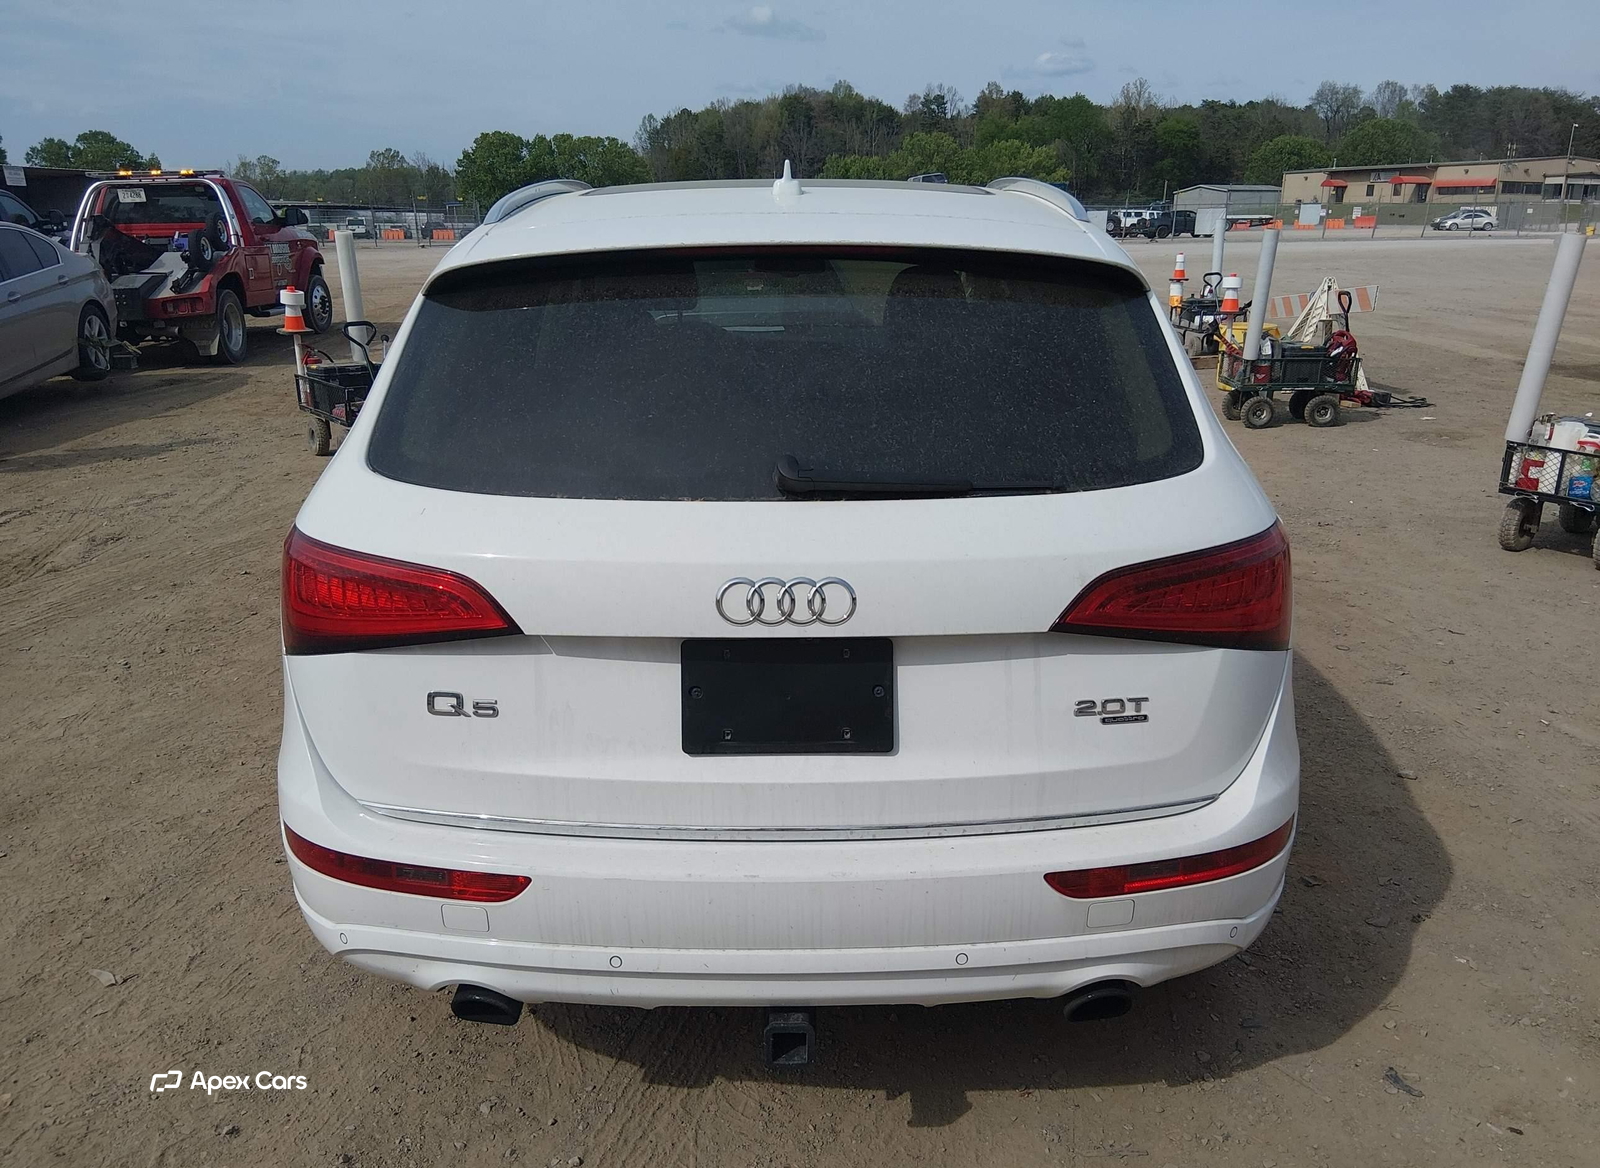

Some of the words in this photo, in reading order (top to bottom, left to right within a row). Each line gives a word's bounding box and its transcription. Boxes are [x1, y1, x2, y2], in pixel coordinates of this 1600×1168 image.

[427, 690, 500, 718] Q5
[1073, 696, 1149, 717] 2.0T
[1103, 715, 1146, 723] quattro
